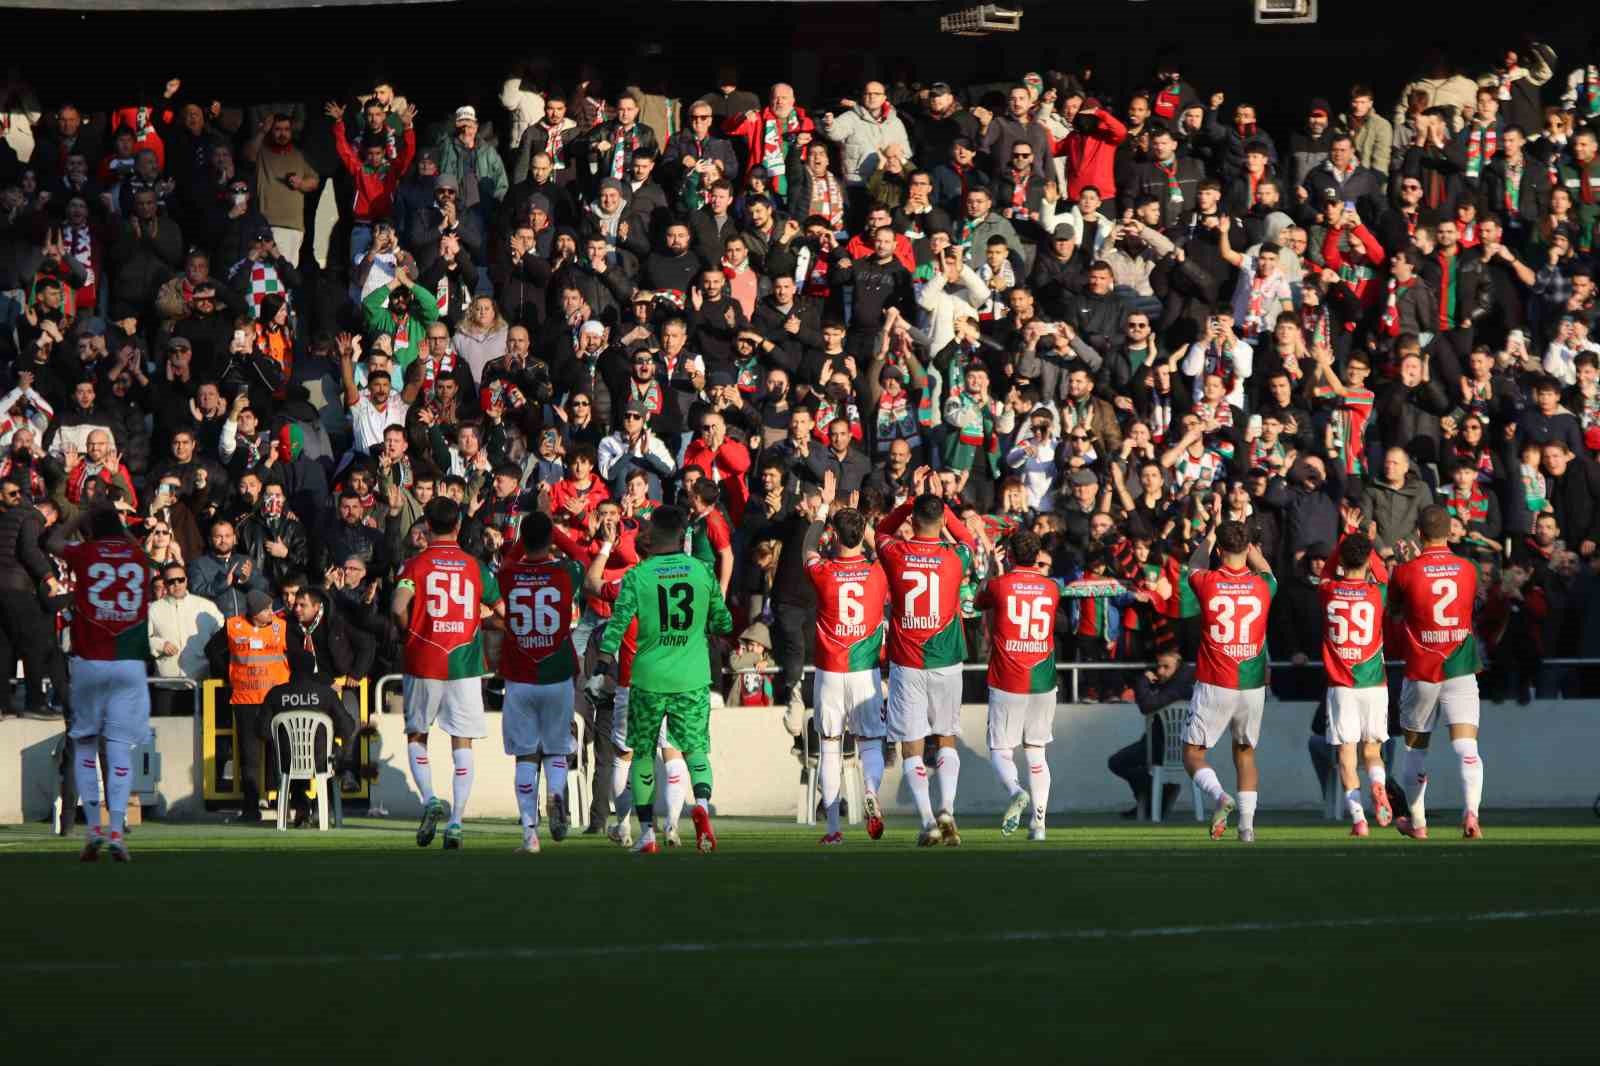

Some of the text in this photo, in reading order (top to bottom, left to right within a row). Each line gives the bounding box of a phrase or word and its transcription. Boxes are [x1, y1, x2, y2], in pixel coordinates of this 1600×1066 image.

[88, 562, 144, 610] 23
[426, 571, 474, 619] 54
[657, 582, 694, 632] 13
[838, 582, 864, 625] 6
[902, 571, 939, 618] 71
[1432, 578, 1458, 626] 2
[432, 620, 465, 633] ENSAR
[509, 586, 561, 636] 56
[834, 623, 867, 637] ALPAY
[1007, 595, 1053, 640] 45
[1208, 595, 1262, 644] 37
[1327, 600, 1375, 646] 59
